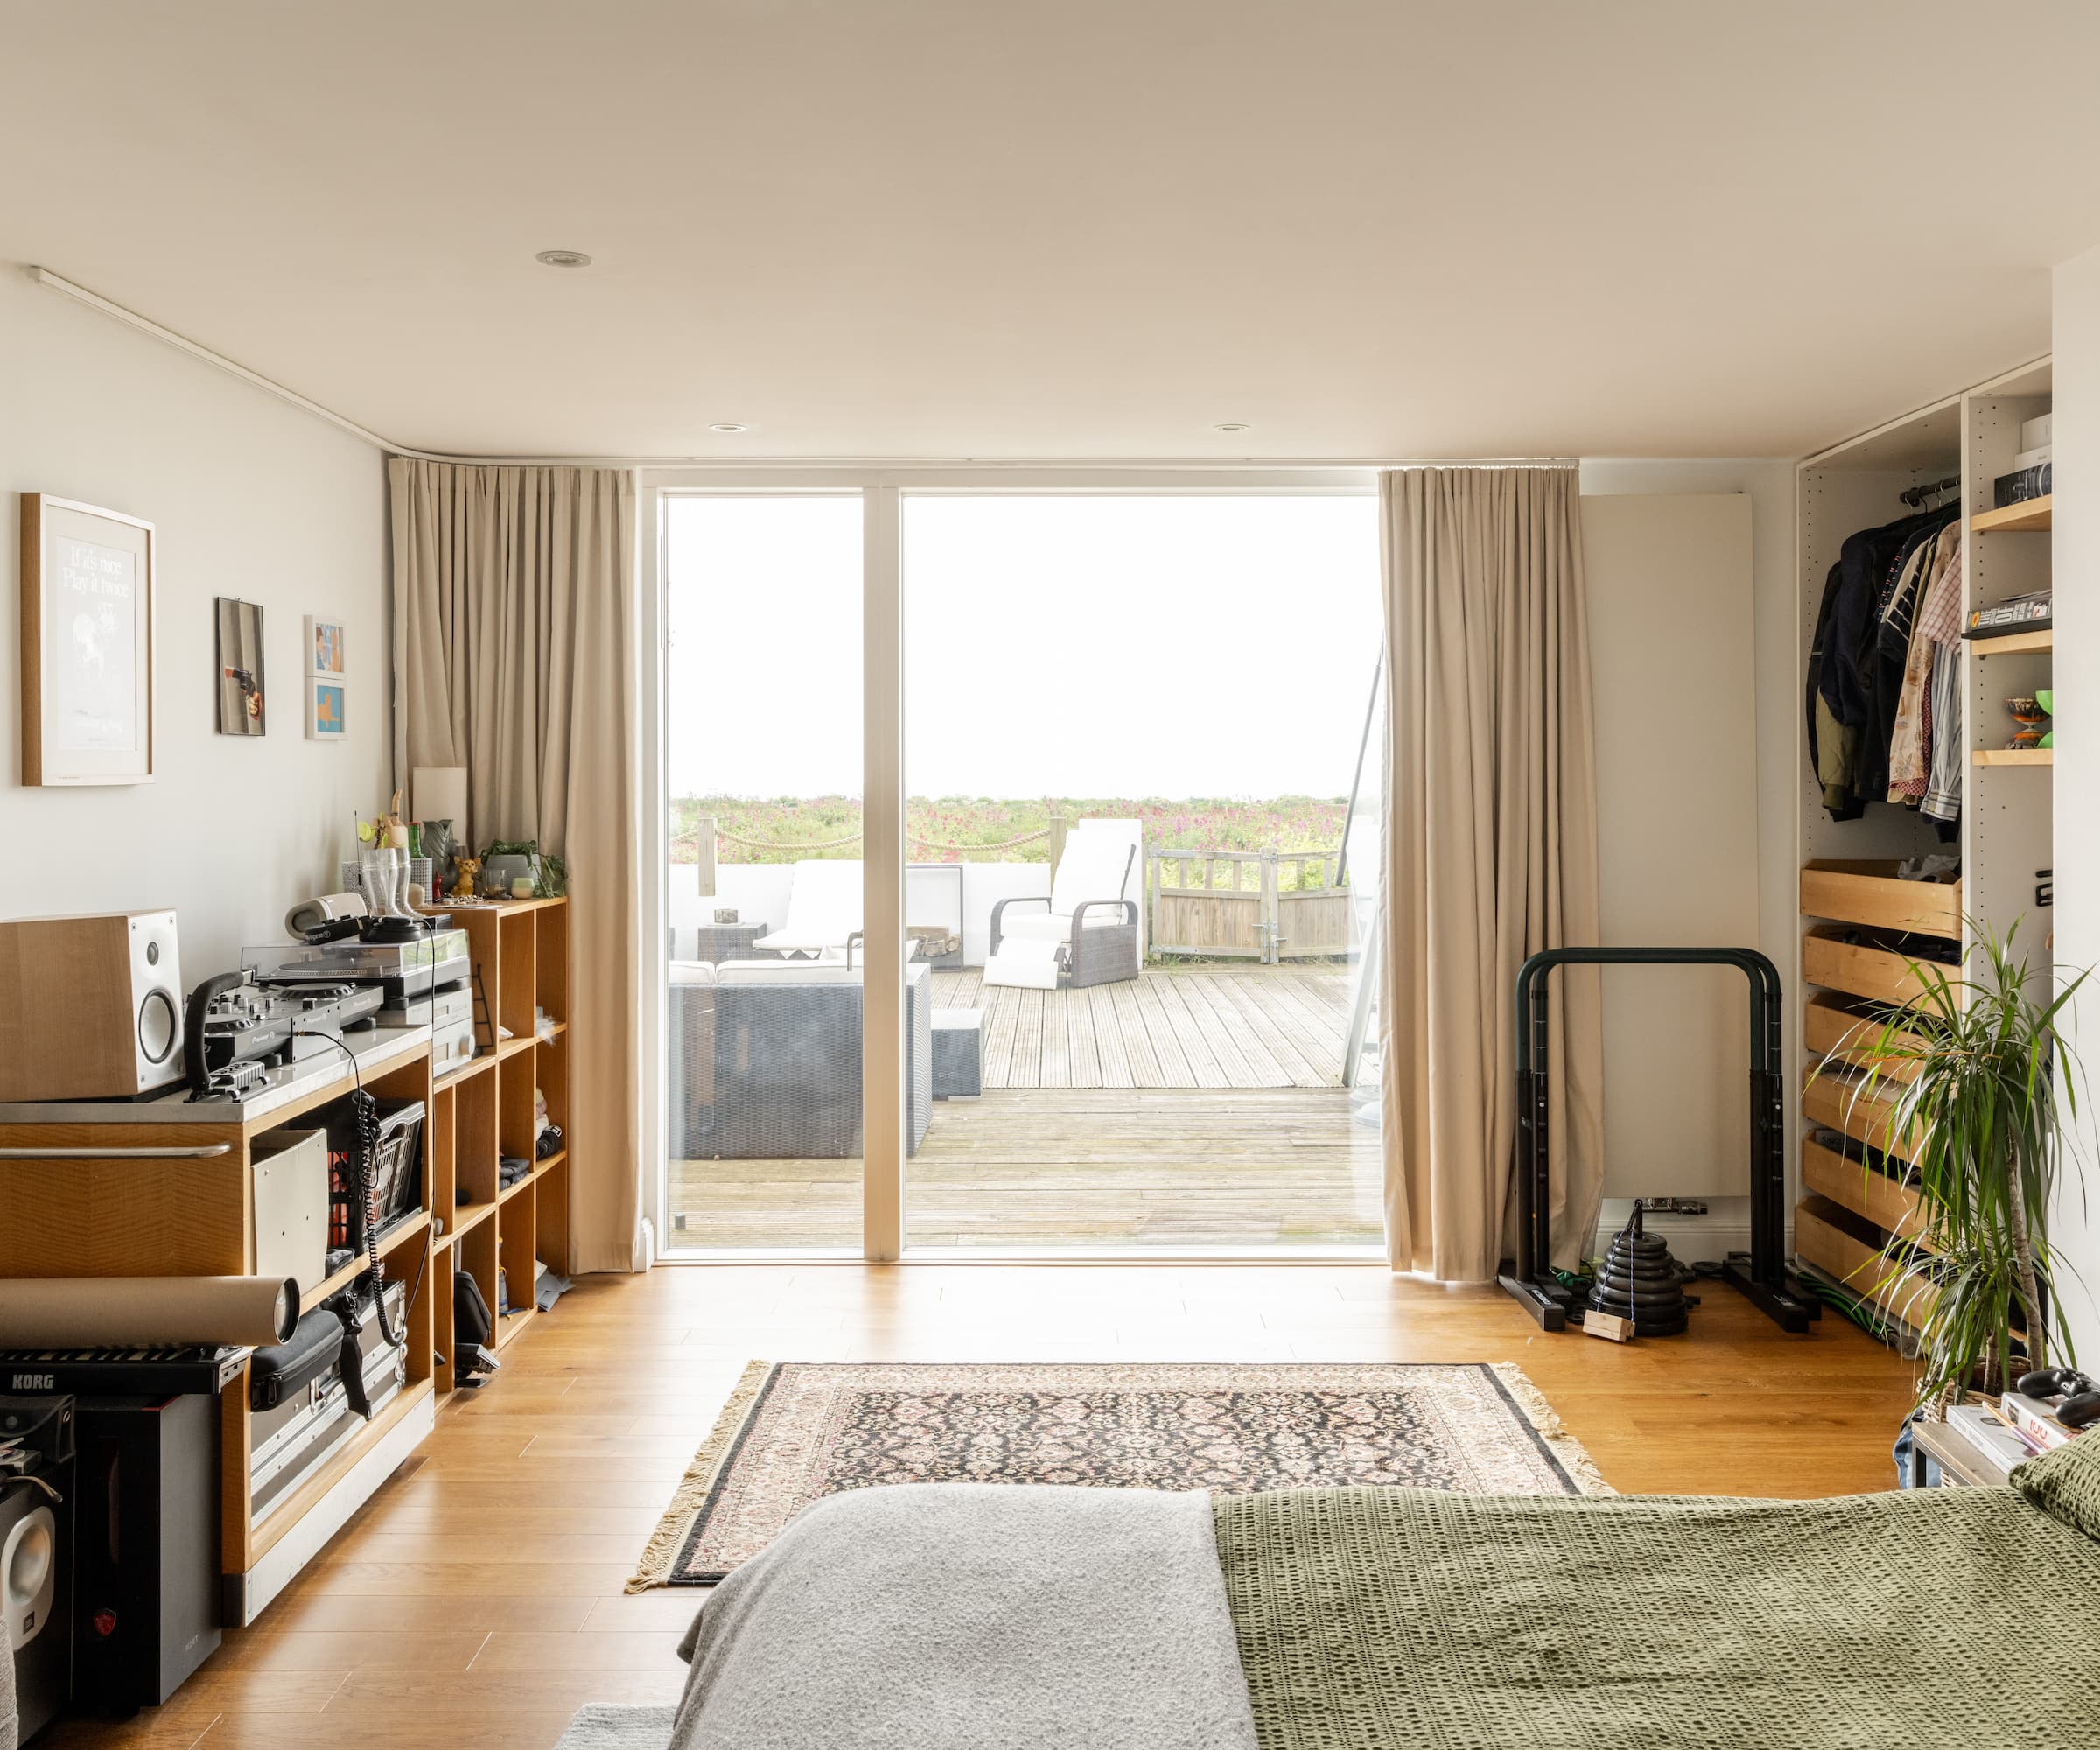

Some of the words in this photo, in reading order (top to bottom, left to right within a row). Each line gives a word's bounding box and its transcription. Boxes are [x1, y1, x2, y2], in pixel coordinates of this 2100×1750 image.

[100, 553, 122, 575] nice
[62, 566, 88, 595] Play
[101, 576, 130, 598] twice
[12, 1374, 54, 1390] KORG
